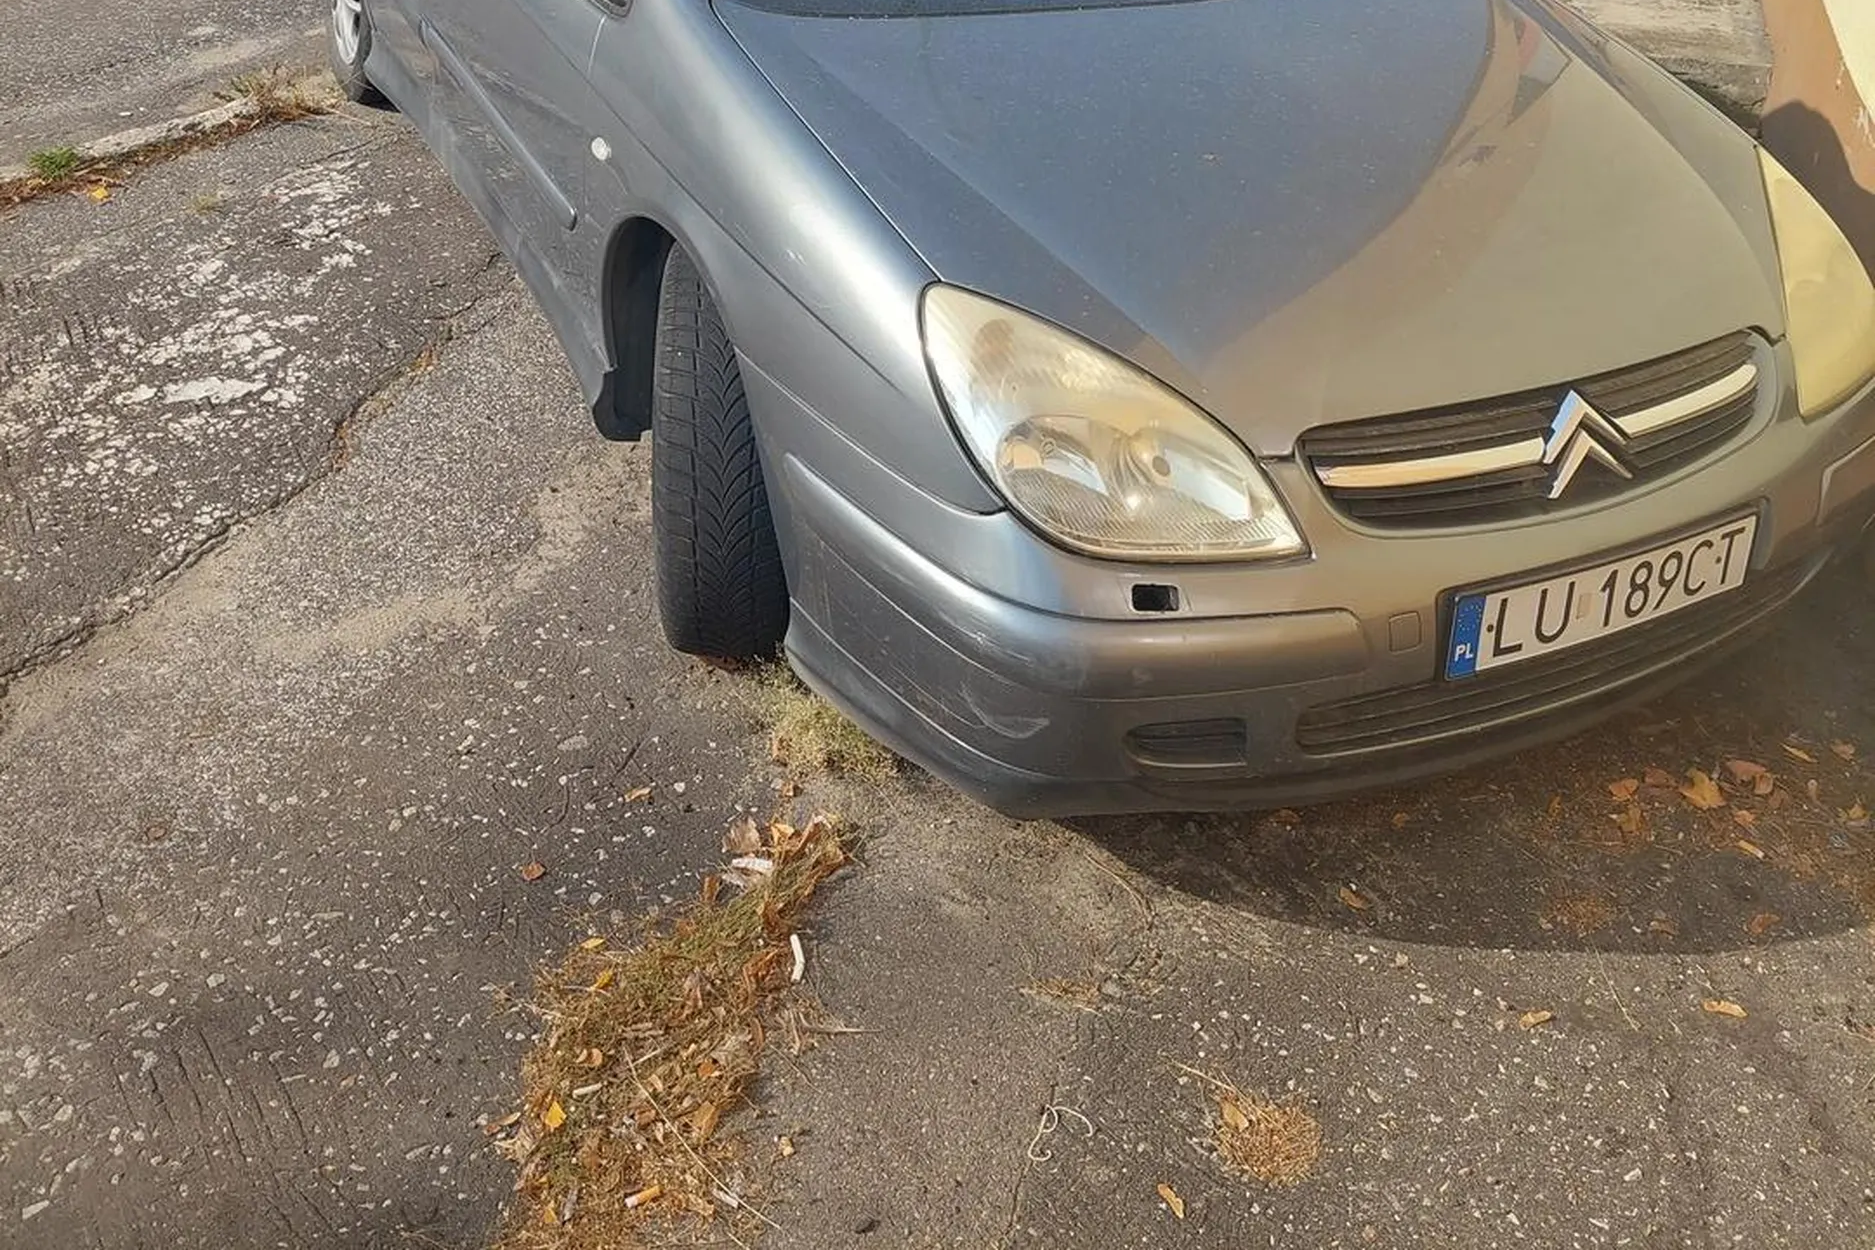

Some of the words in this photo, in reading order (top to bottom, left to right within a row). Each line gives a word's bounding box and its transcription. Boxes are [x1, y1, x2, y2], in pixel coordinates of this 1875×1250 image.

[1492, 581, 1576, 657] LU
[1600, 526, 1746, 628] 189CT
[1454, 643, 1474, 662] PL
